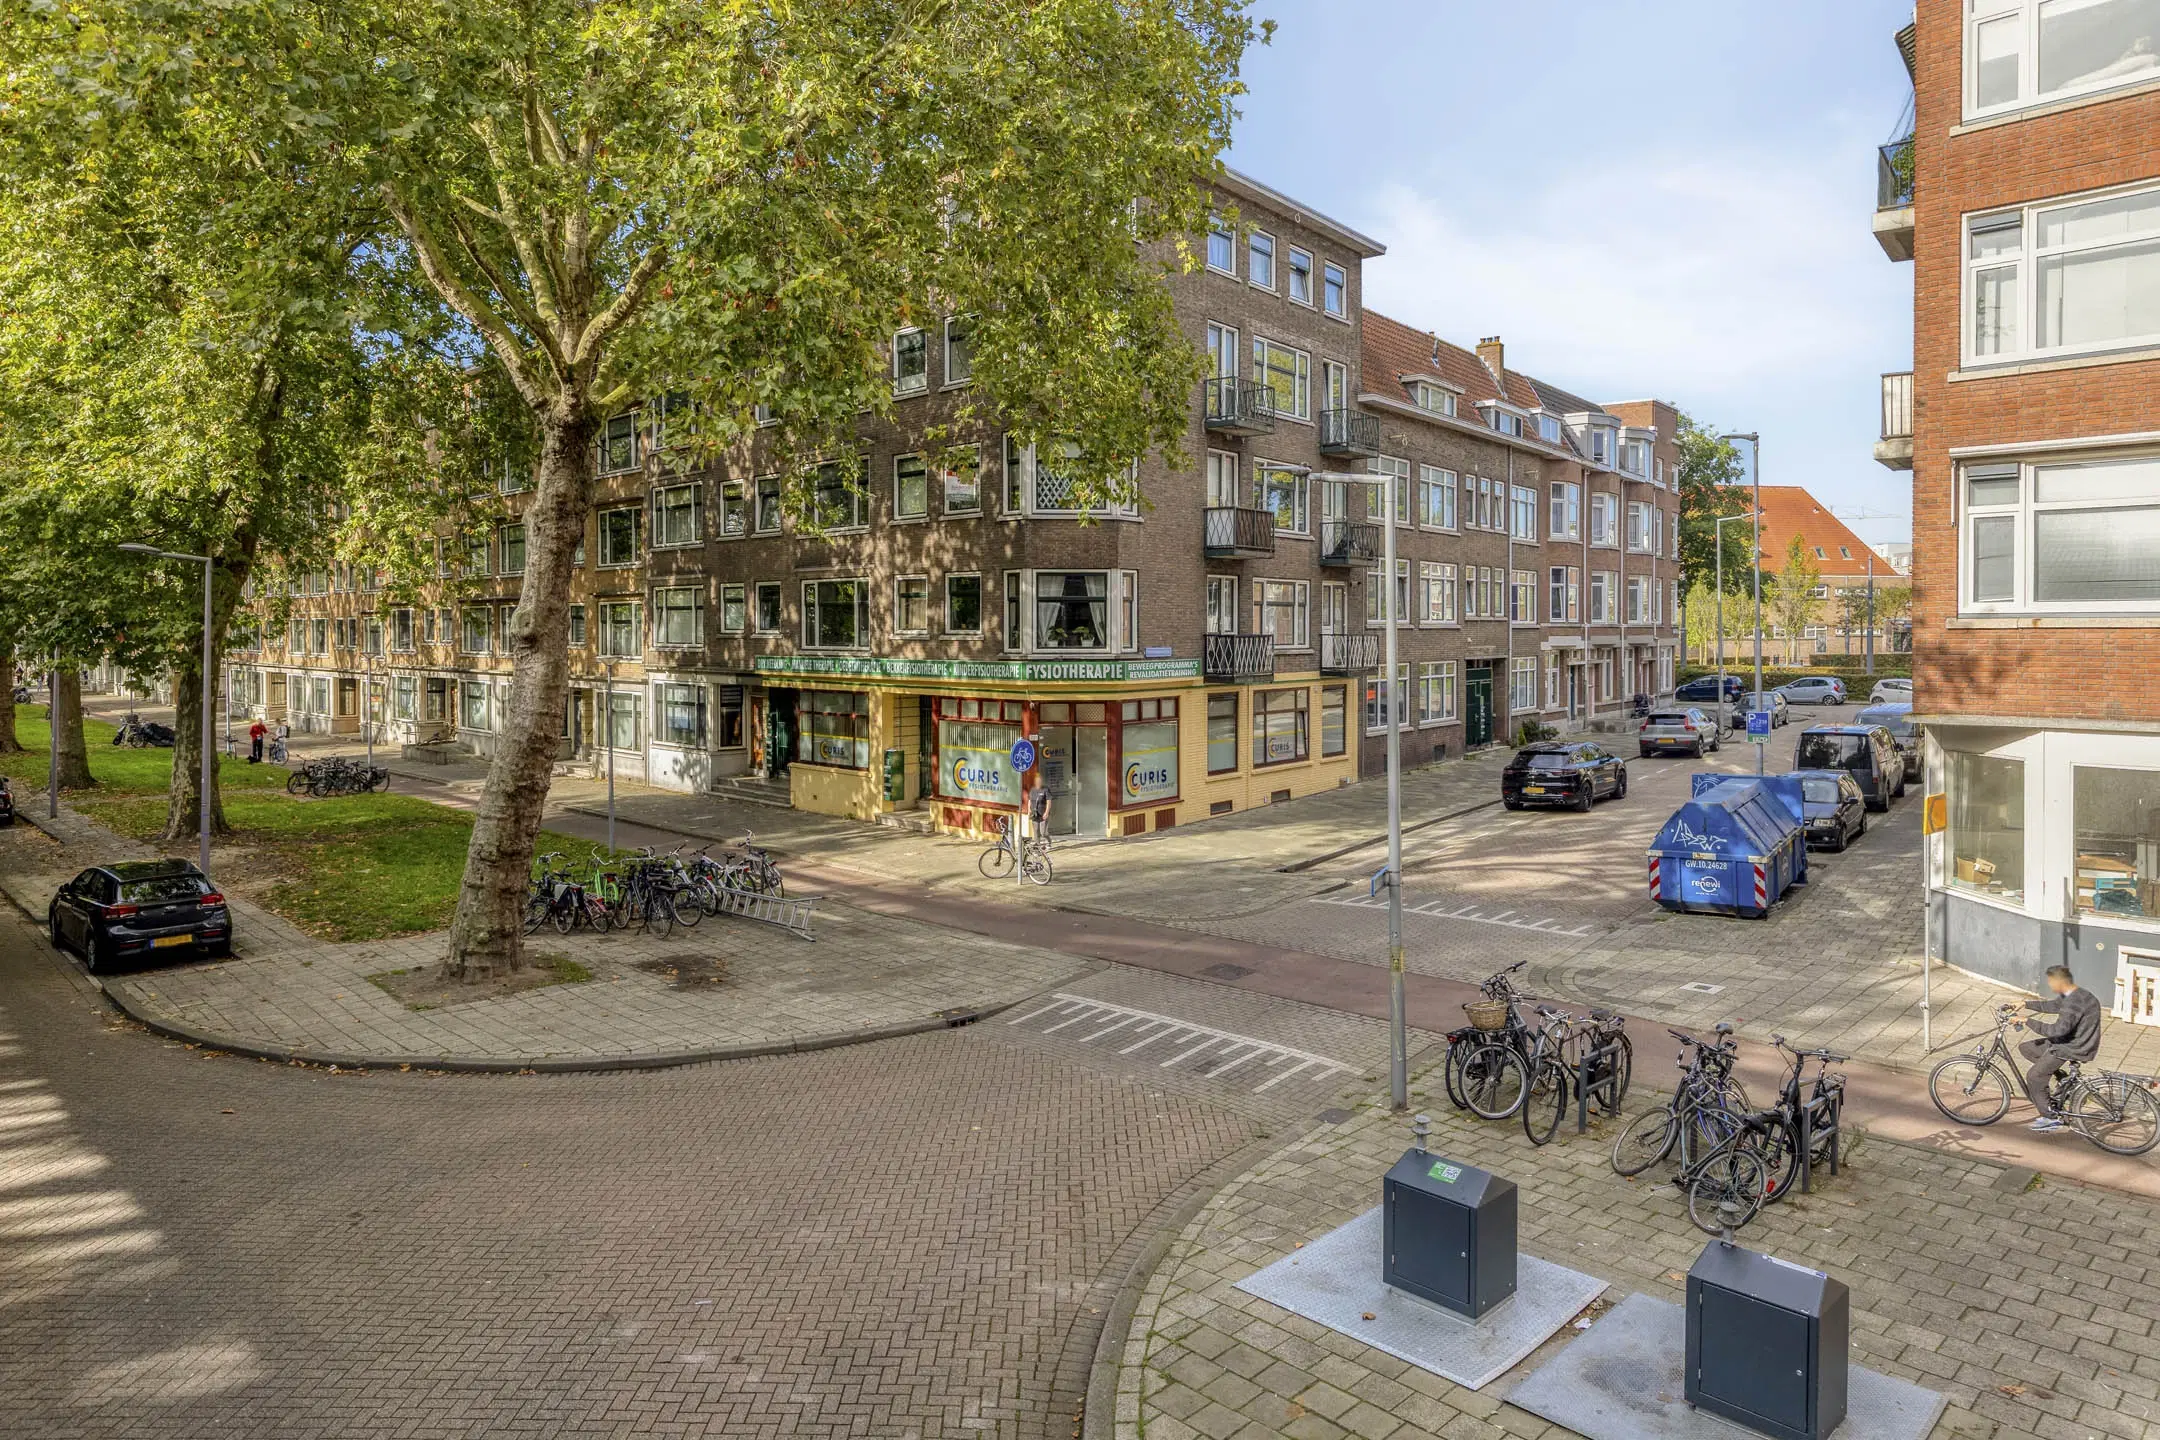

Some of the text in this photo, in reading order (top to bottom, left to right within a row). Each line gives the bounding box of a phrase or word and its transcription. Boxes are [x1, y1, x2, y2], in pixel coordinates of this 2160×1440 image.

[953, 664, 1020, 678] KINDERFYSIOTHERAPIE
[1025, 664, 1123, 679] FYSIOTHERAPIE
[1748, 713, 1757, 724] P
[1685, 860, 1728, 870] GW.10.24628
